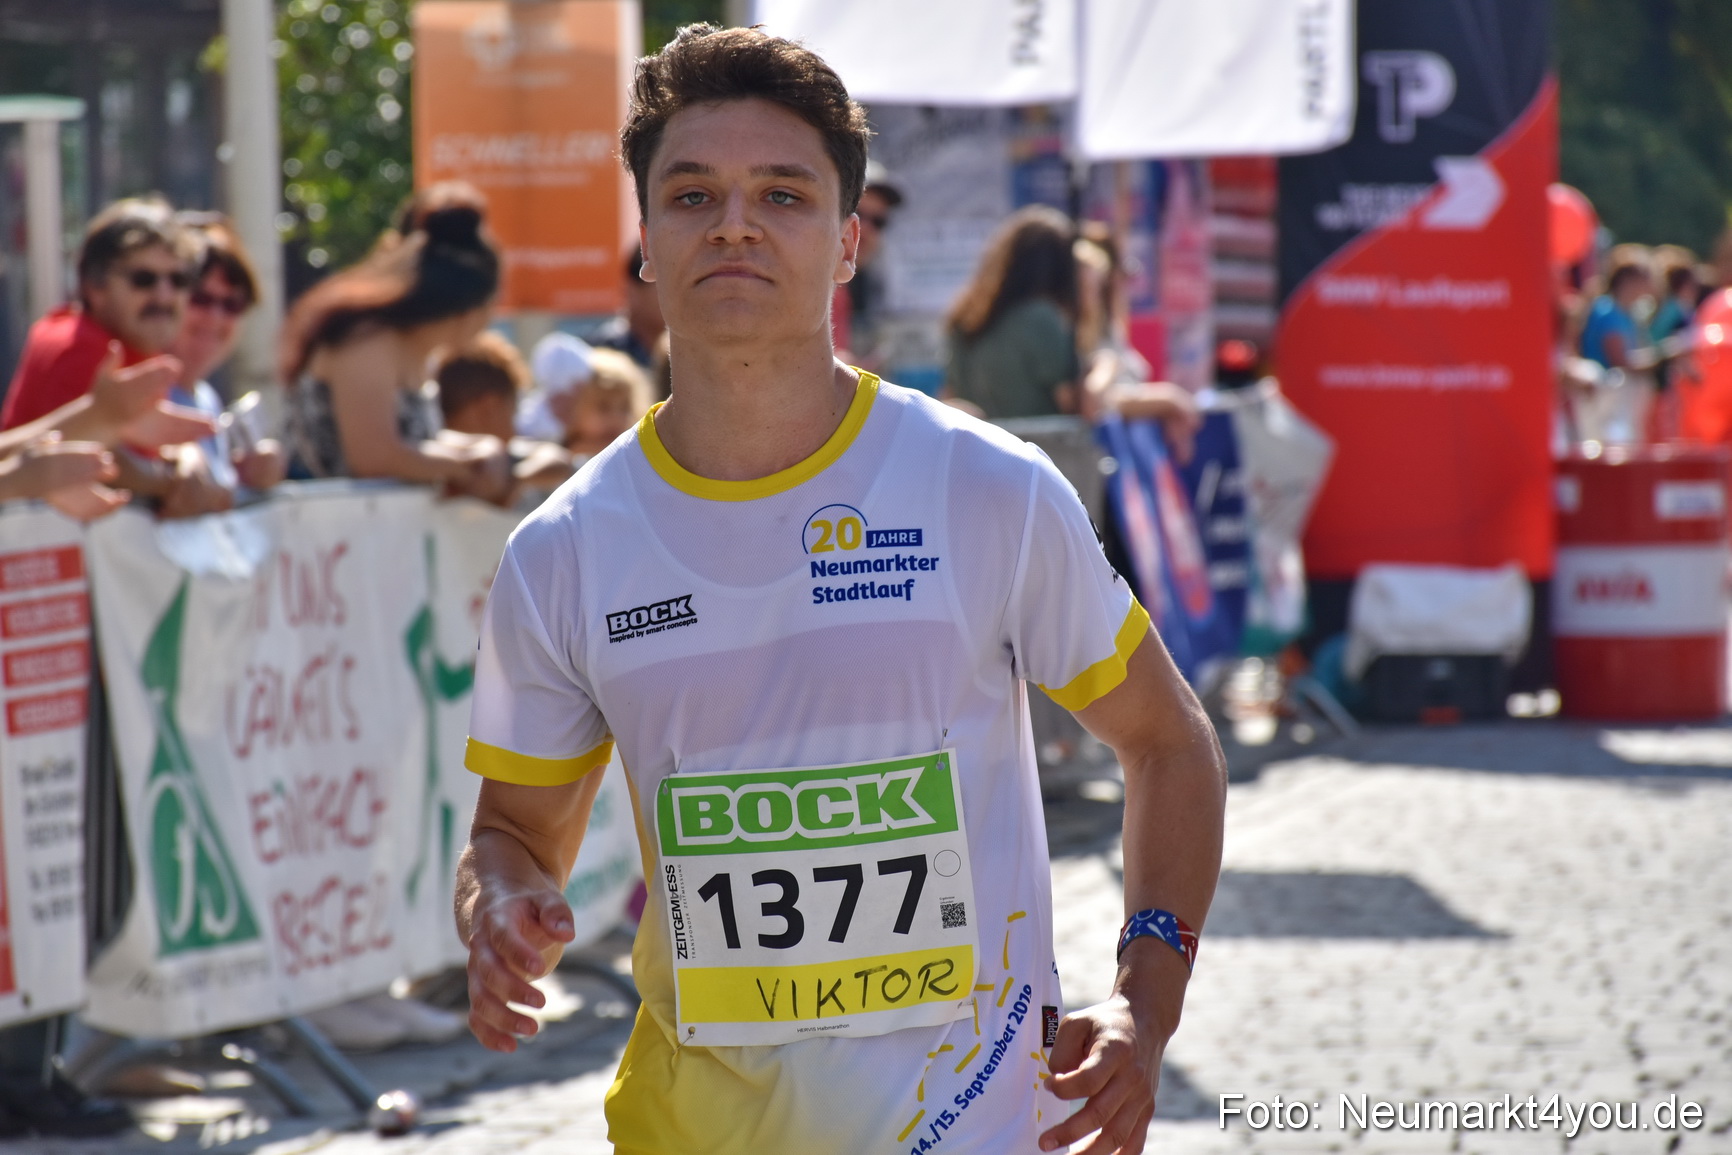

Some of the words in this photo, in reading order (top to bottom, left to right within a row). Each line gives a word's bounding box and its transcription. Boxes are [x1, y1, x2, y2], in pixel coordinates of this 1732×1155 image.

[810, 516, 862, 553] 20
[871, 531, 918, 547] JAHRE
[810, 554, 939, 578] Neumarkter
[812, 579, 915, 604] Stadtlauf
[607, 596, 694, 634] BOCK
[609, 631, 635, 643] inspired
[636, 630, 644, 638] by
[646, 624, 666, 635] smart
[666, 617, 698, 630] concepts
[675, 769, 933, 843] BOCK
[697, 854, 928, 949] 1377
[756, 958, 959, 1019] VIKTOR
[953, 1024, 1017, 1110] September
[1007, 984, 1032, 1025] 2019
